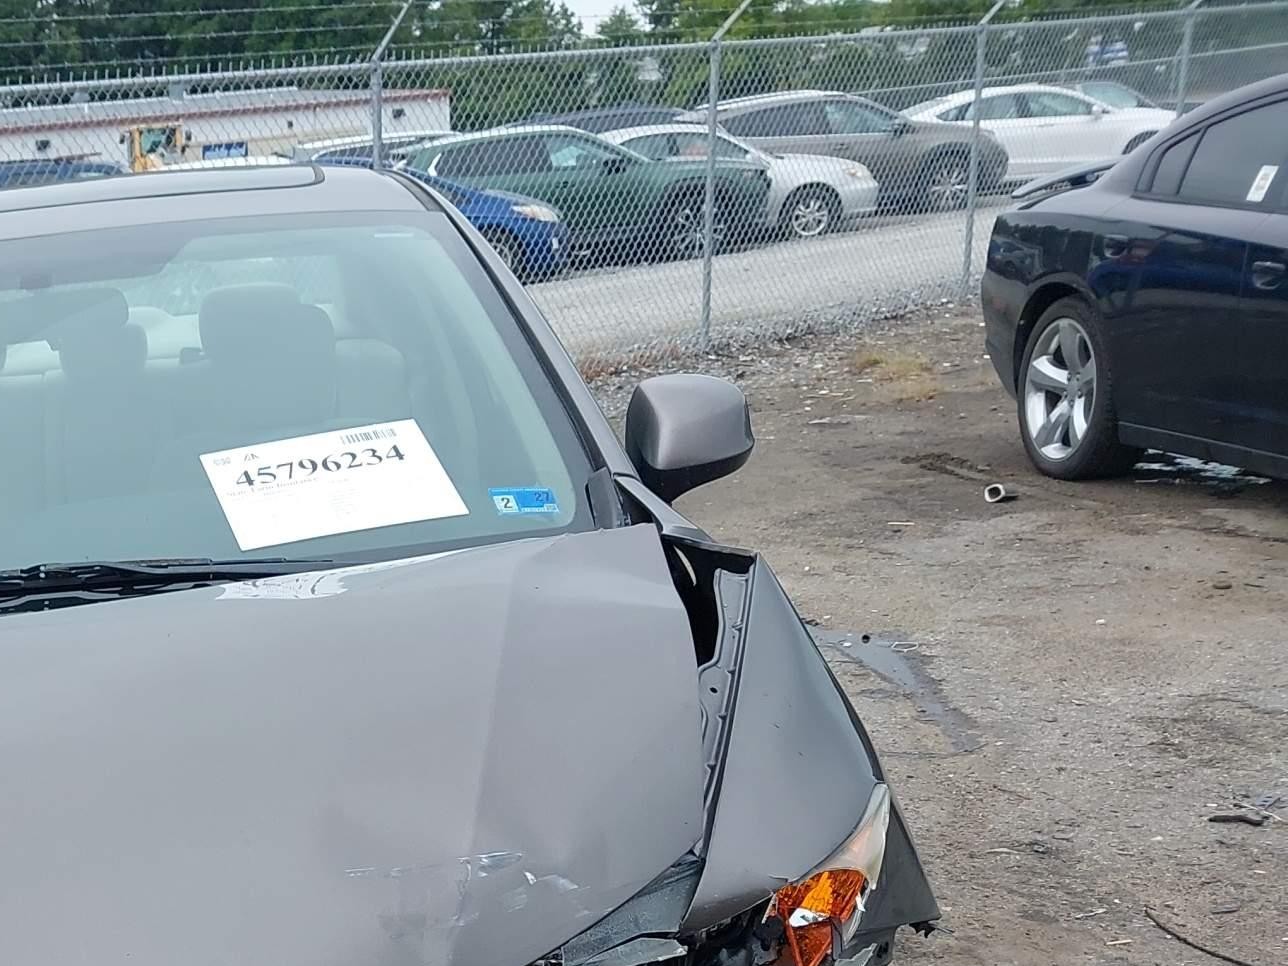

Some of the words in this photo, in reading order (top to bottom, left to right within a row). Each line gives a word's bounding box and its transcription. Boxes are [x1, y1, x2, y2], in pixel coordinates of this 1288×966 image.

[236, 444, 405, 486] 45796234
[534, 491, 550, 502] 27
[500, 497, 513, 509] 2
